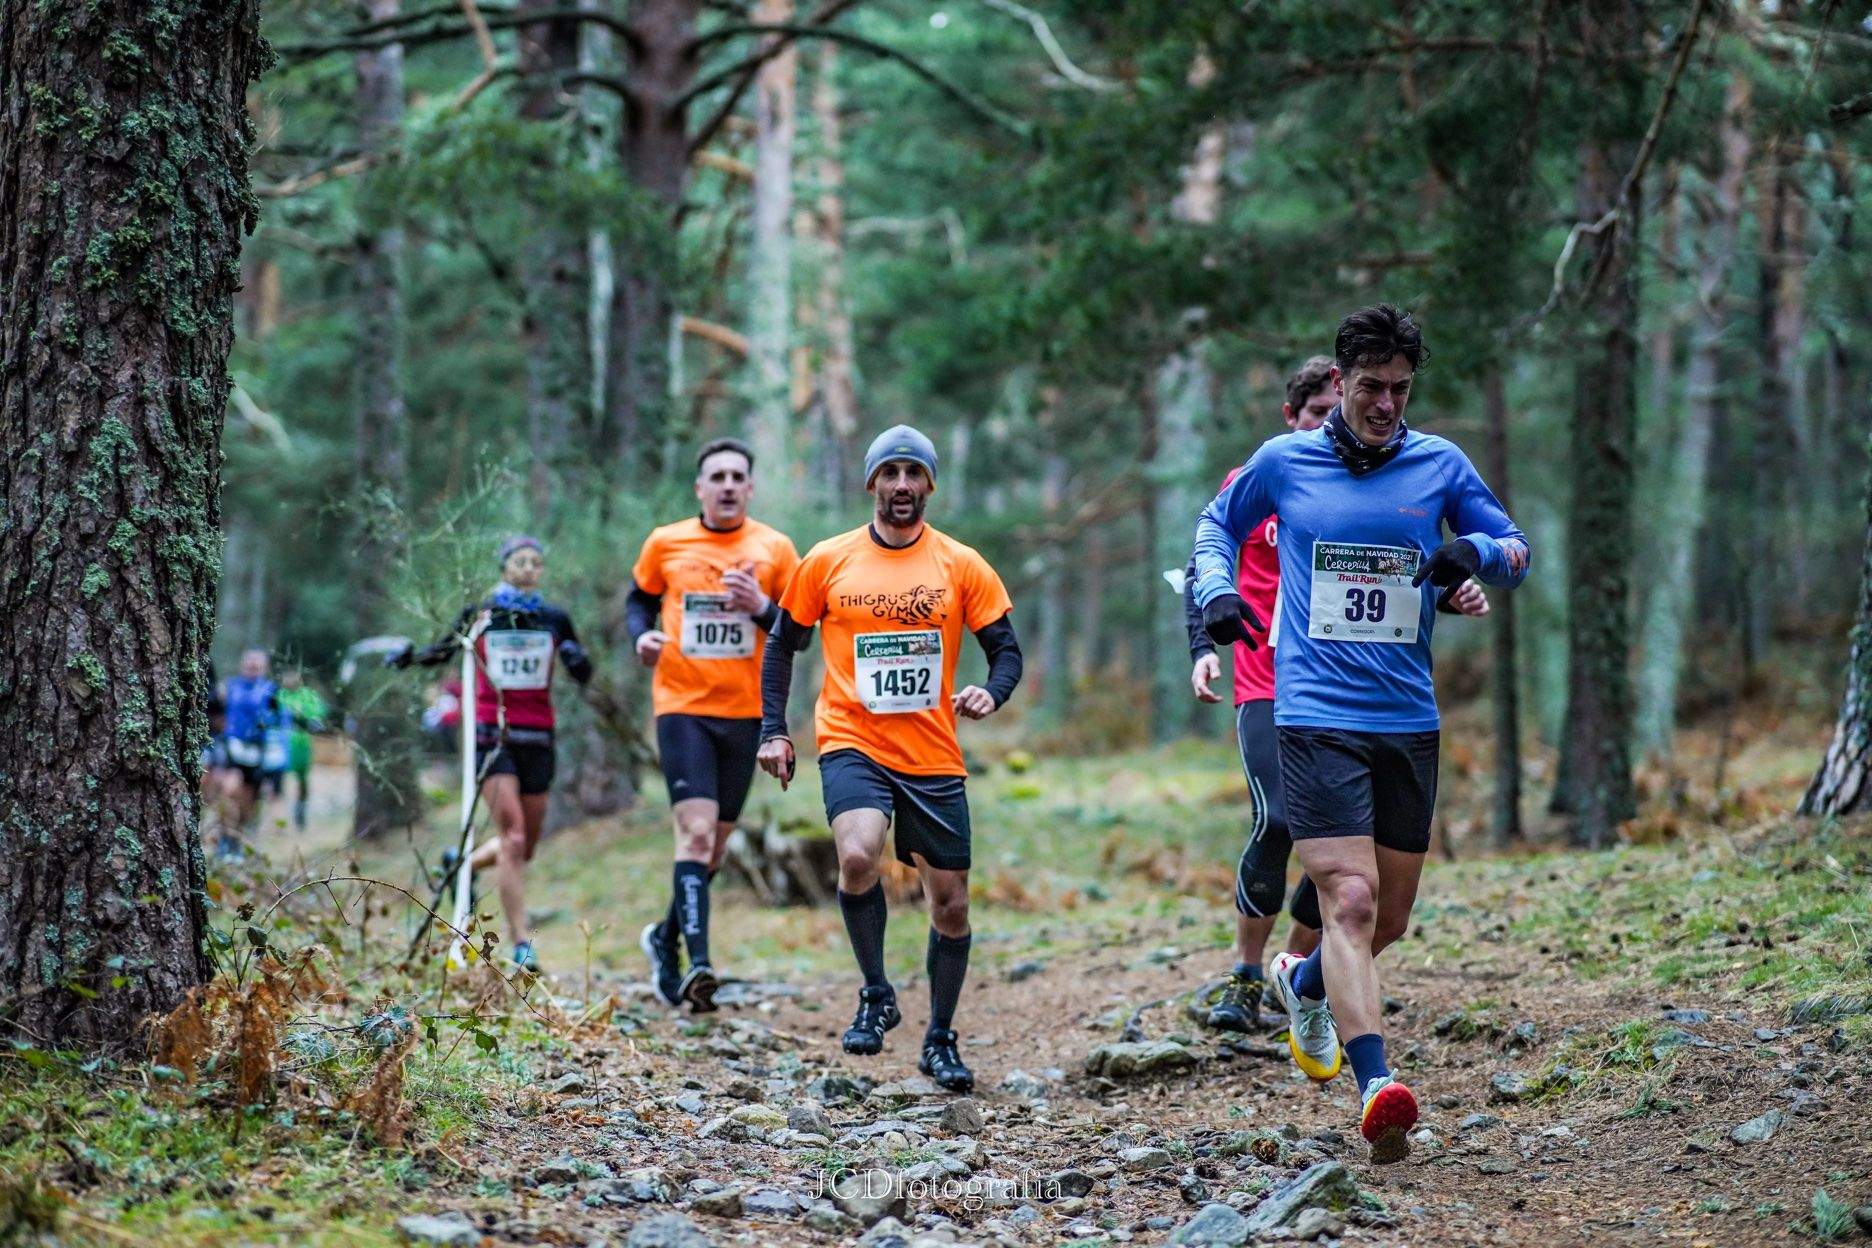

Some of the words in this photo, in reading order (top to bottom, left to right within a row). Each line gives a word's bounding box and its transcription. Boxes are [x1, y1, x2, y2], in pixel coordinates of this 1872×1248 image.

[1320, 546, 1355, 556] CARRERA
[1366, 550, 1399, 559] NAVIDAD
[1337, 573, 1358, 583] Trail
[872, 606, 909, 619] GYM
[1345, 588, 1386, 622] 39
[695, 622, 742, 645] 1075
[870, 667, 931, 697] 1452
